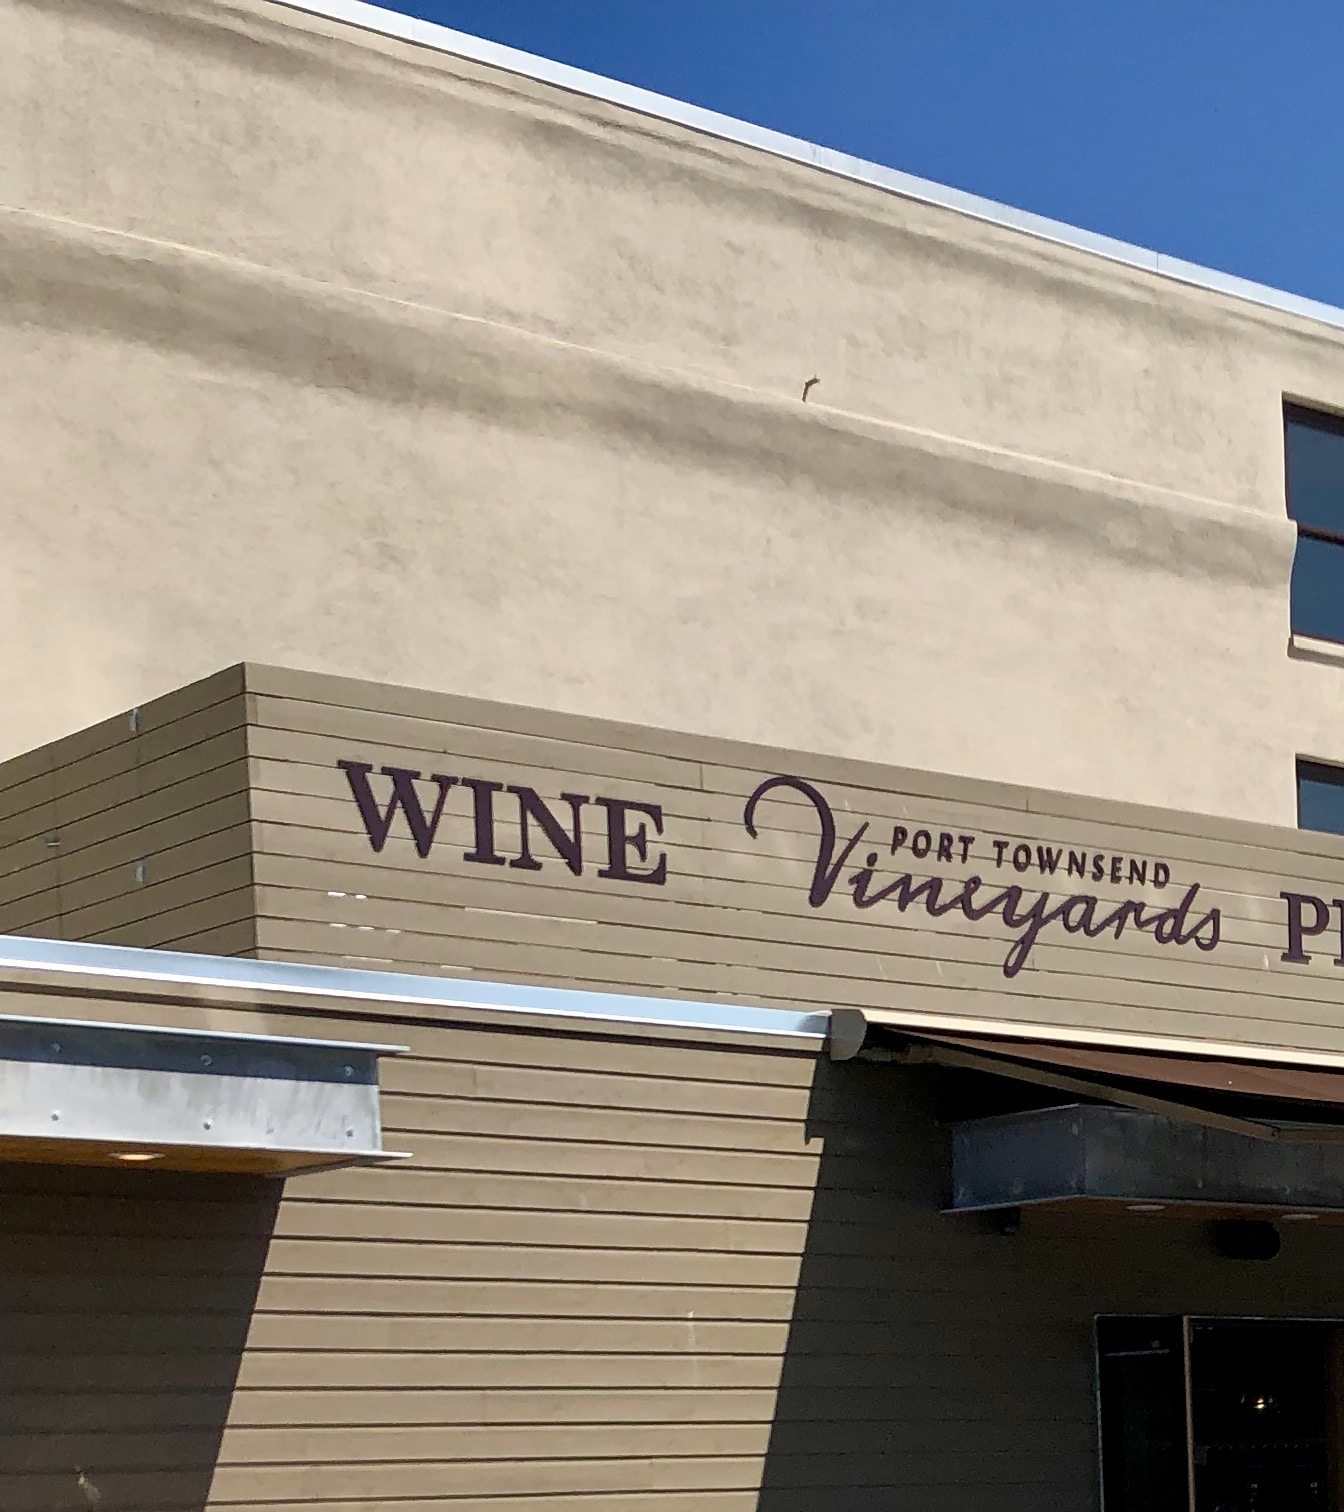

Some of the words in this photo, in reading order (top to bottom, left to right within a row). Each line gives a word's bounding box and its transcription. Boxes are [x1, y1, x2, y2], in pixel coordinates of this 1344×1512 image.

[337, 759, 668, 886] WINE
[744, 775, 1222, 978] Vineyards
[891, 826, 974, 864] PORT
[992, 840, 1170, 889] TOWNSEND
